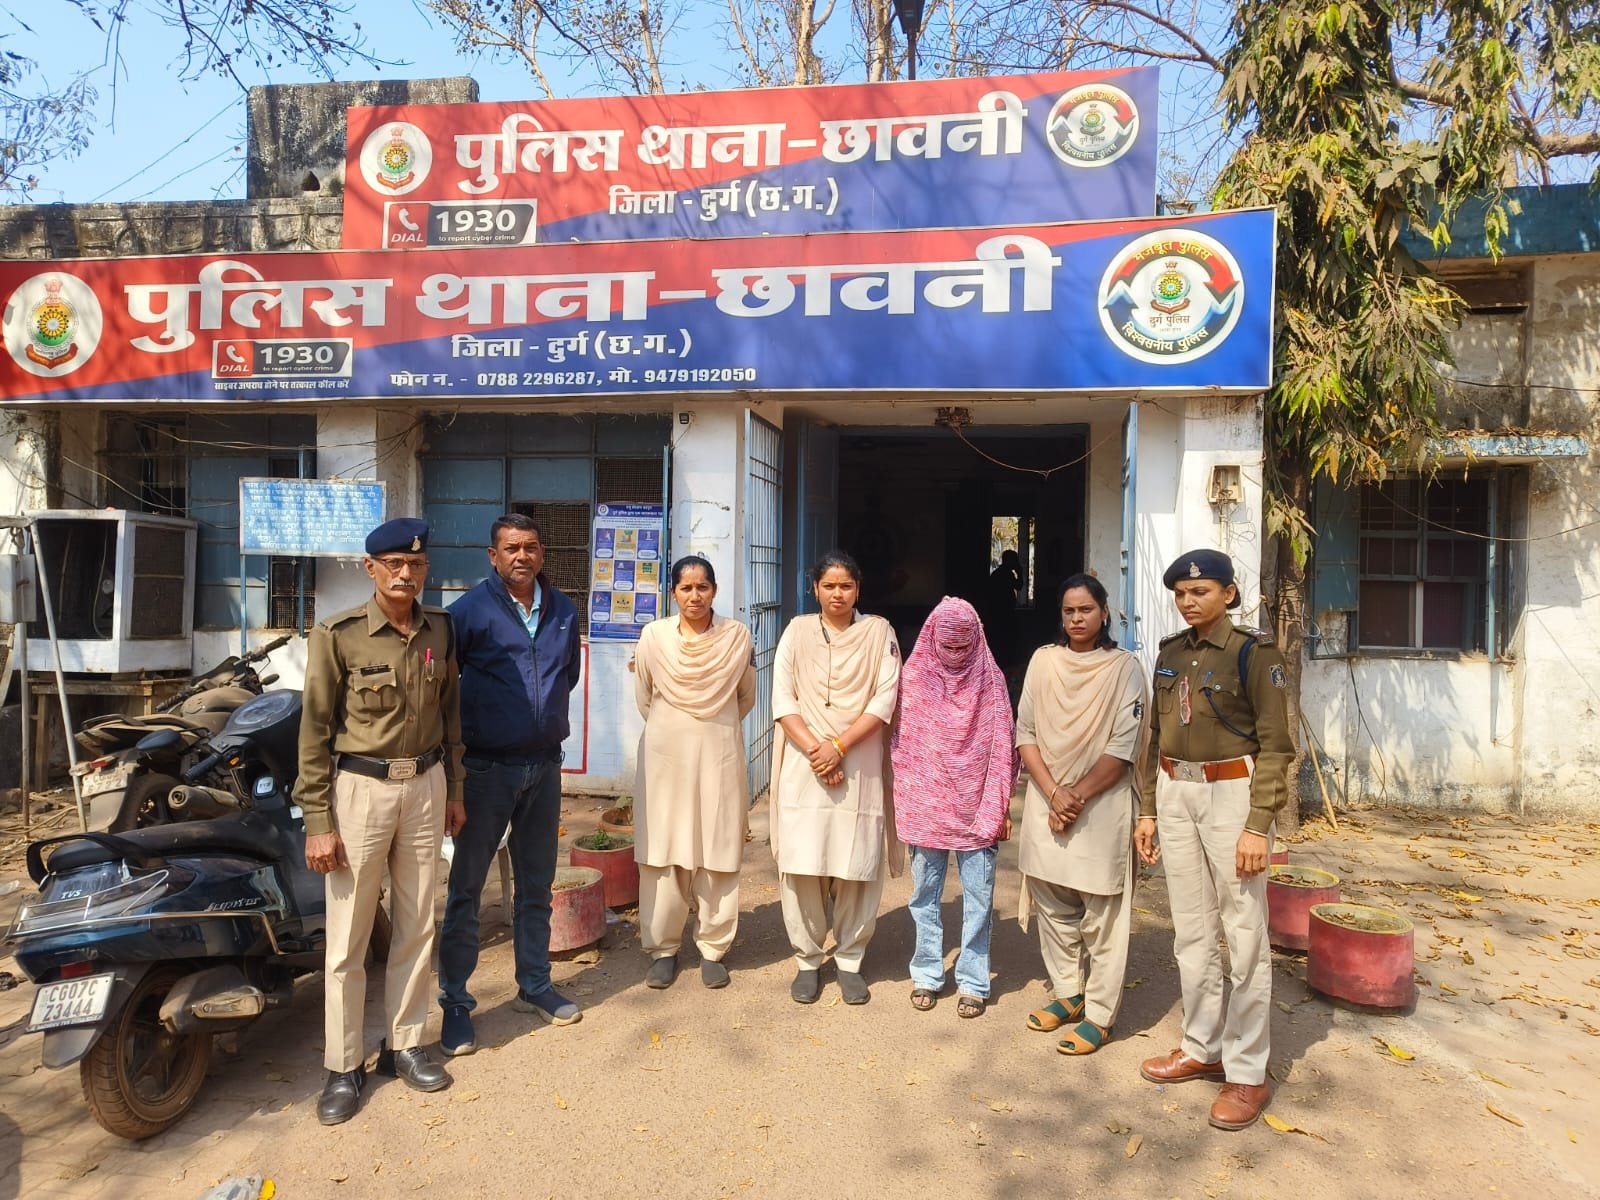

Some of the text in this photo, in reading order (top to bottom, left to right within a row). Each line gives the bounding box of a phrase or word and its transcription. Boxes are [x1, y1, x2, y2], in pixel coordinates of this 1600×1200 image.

[453, 113, 625, 195] पुलिस
[608, 184, 678, 214] जिला
[700, 179, 741, 222] दुर्ग
[436, 209, 516, 233] 1930
[391, 233, 424, 243] DIAL
[472, 234, 492, 242] cyber
[1133, 240, 1213, 262] मजबूत पुलिस
[123, 259, 393, 353] पुलिस
[1166, 313, 1190, 326] पुलिस
[451, 333, 524, 358] जिला
[547, 331, 590, 362] दुर्ग
[1122, 320, 1209, 351] विश्वसनीय पुलिस
[260, 346, 334, 364] 1930
[219, 364, 250, 372] DIAL
[390, 371, 429, 386] फोन
[477, 373, 518, 386] 0788
[608, 366, 638, 383] मो.
[644, 368, 756, 383] 9479192050
[61, 889, 82, 900] TVS
[49, 980, 98, 1002] CG07C
[43, 998, 93, 1022] Z3444
